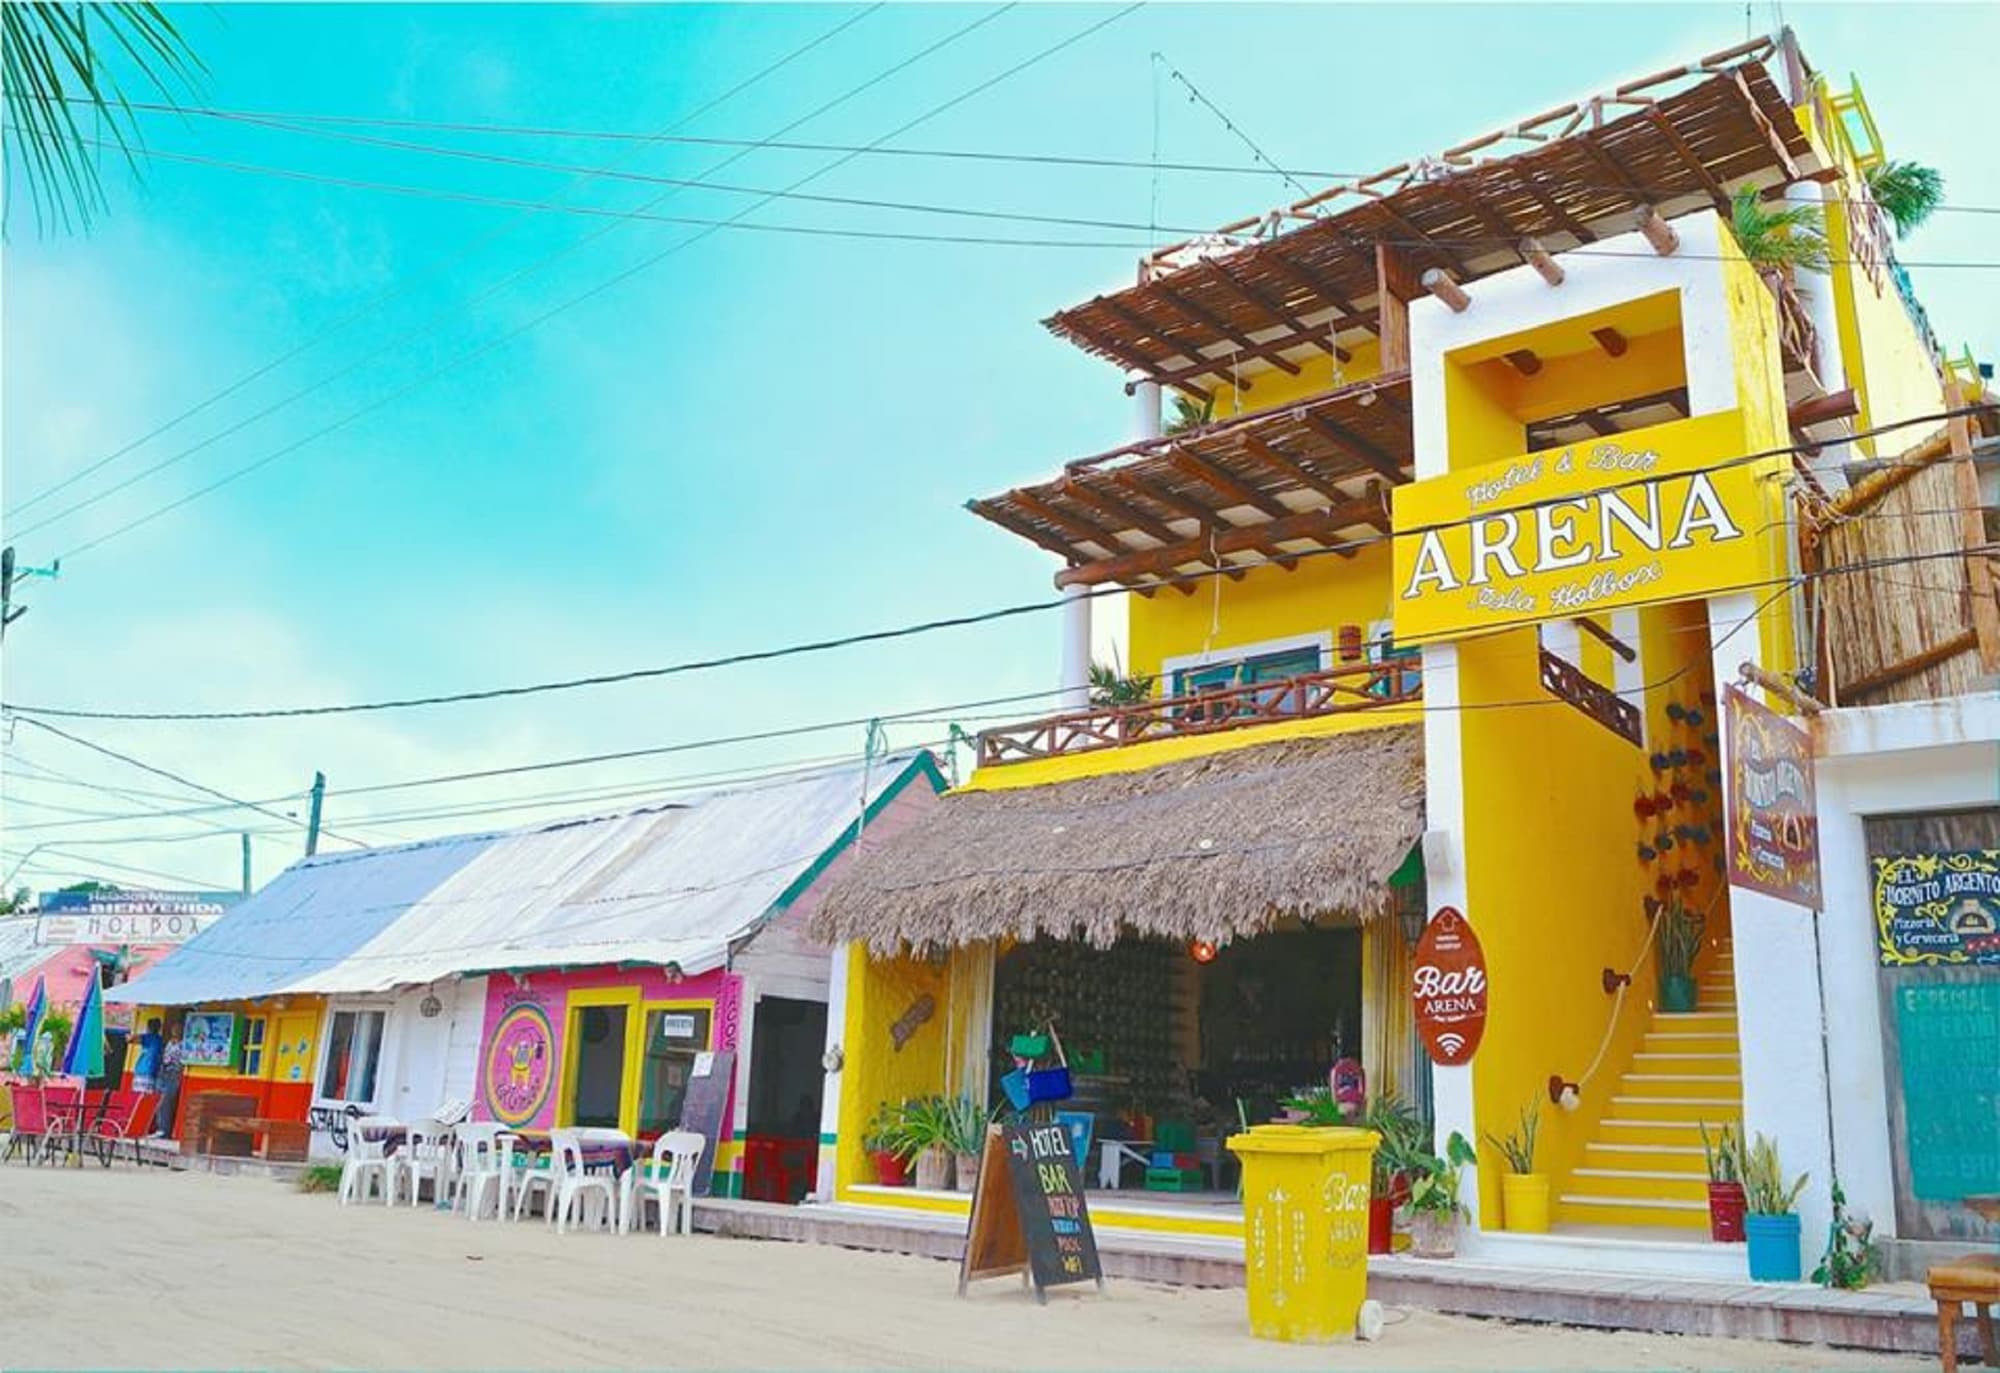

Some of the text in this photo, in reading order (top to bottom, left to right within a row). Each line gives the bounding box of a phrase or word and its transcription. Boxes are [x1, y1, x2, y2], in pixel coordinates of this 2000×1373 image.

[1466, 444, 1659, 510] Hotel & Bar
[1403, 470, 1744, 599] ARENA
[1551, 560, 1662, 610] Holbox
[1885, 871, 2000, 907] HORNITO ARGENTO
[1413, 966, 1485, 999] Bar
[1424, 997, 1477, 1015] ARENA
[1029, 1127, 1070, 1159] HOTEL
[1038, 1163, 1073, 1194] BAR
[1324, 1171, 1368, 1213] Bar
